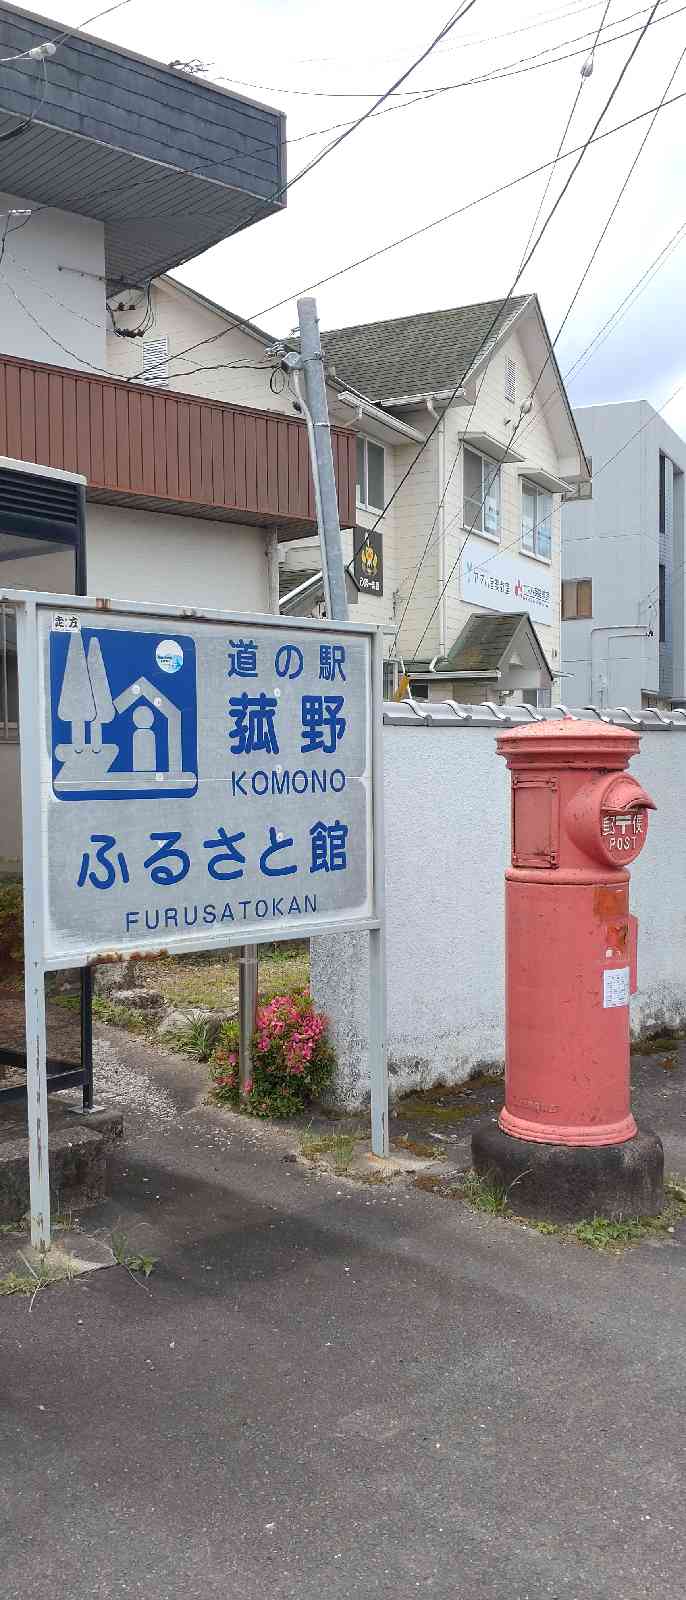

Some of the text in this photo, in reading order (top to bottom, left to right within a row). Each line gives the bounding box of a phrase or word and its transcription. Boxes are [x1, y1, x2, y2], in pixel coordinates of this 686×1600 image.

[227, 639, 347, 682] 道の駅
[228, 691, 347, 755] 菰野
[231, 768, 346, 797] KOMONO
[77, 819, 349, 890] ふるさと館
[609, 835, 637, 851] POST
[125, 894, 318, 932] FURUSATOKAN
